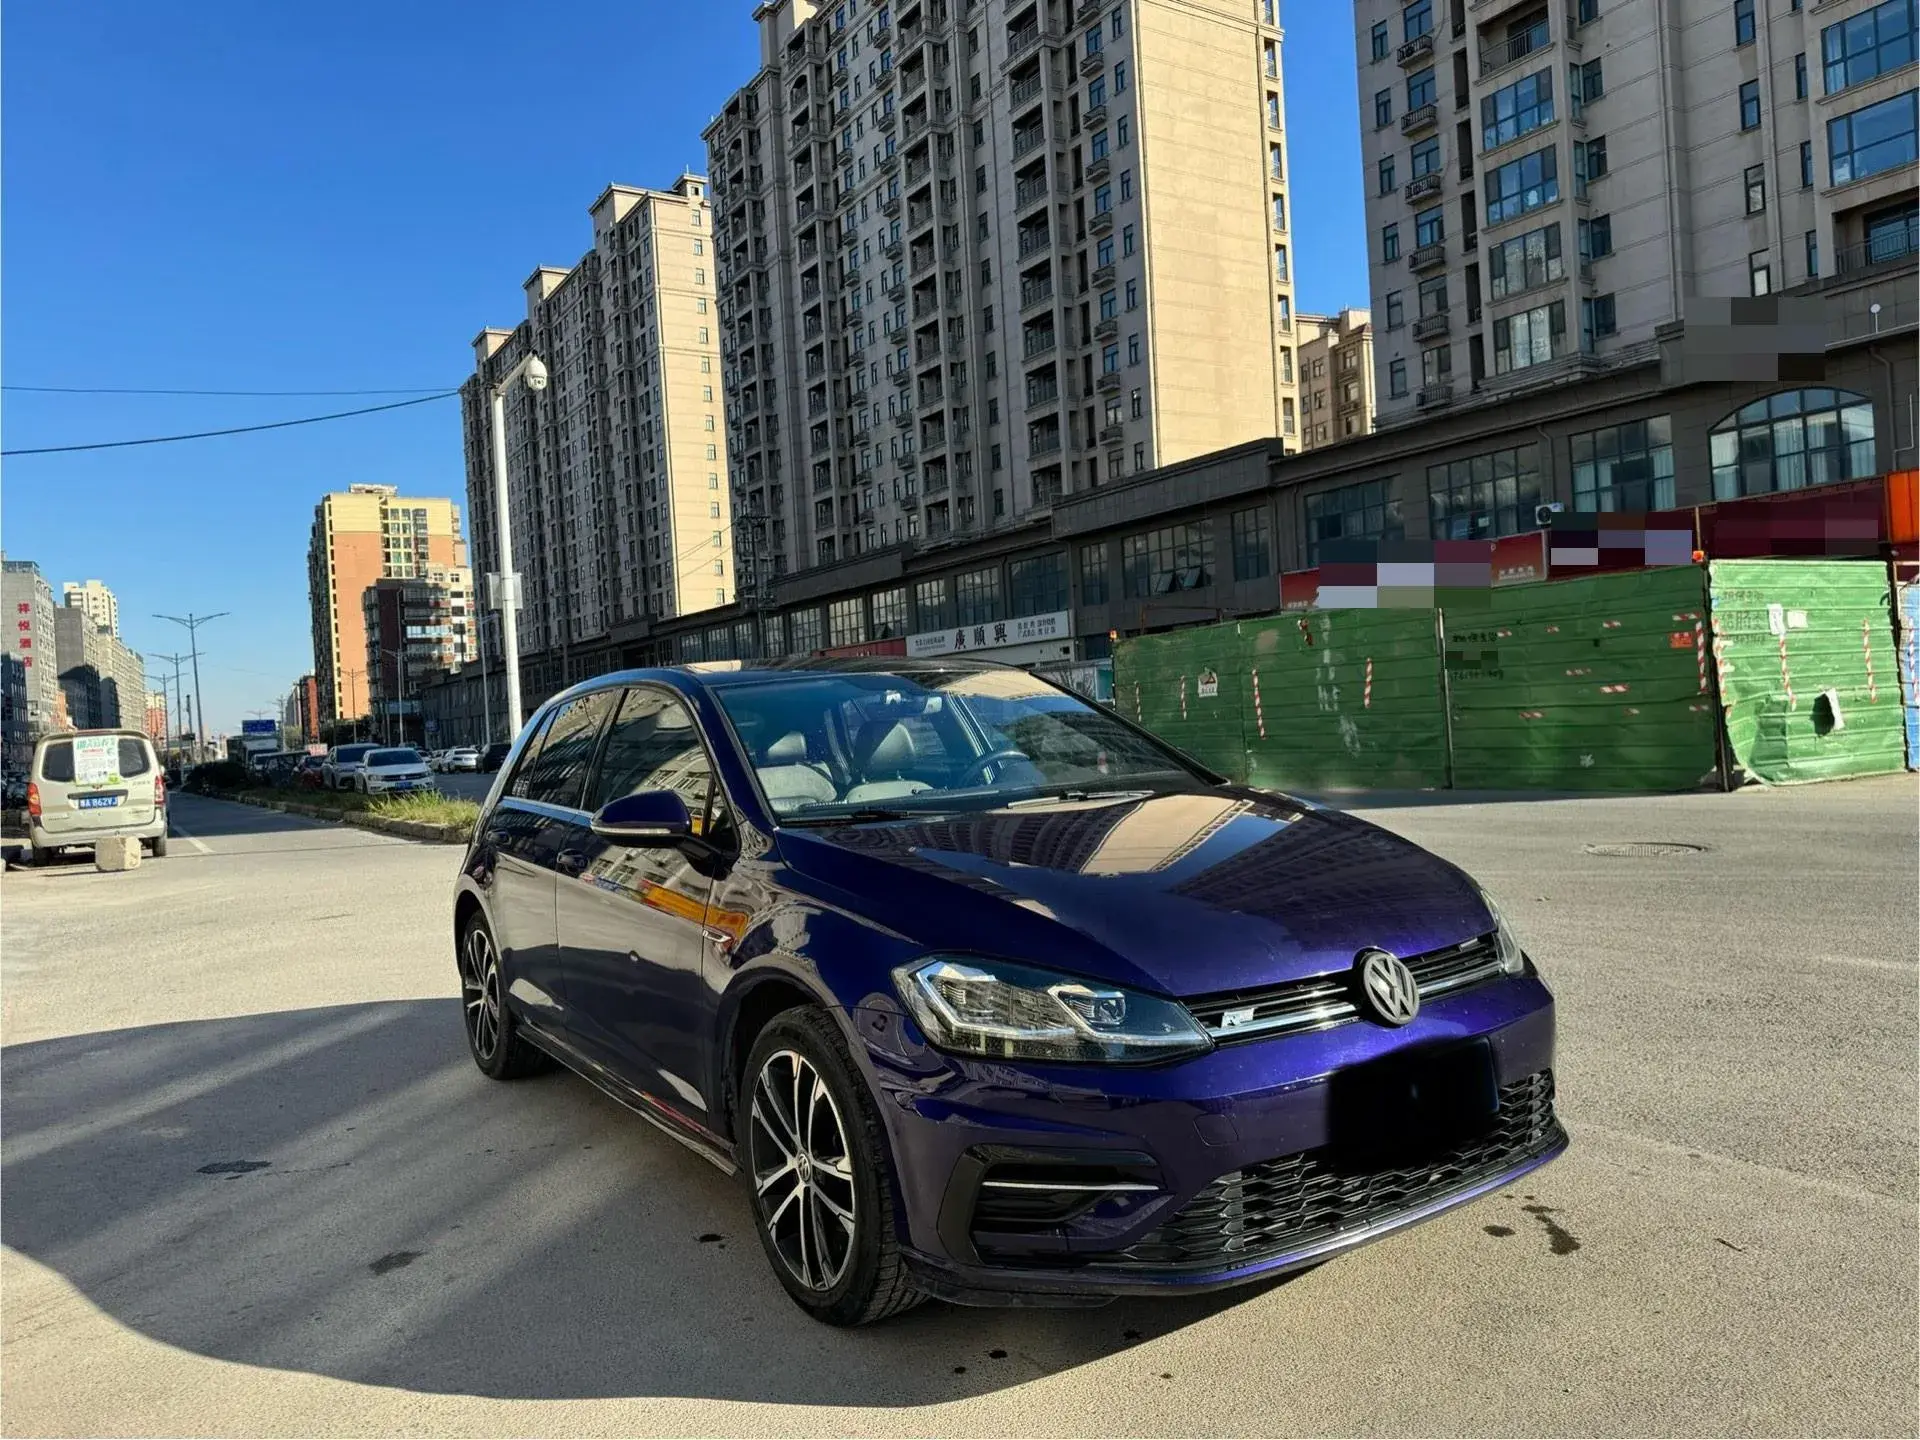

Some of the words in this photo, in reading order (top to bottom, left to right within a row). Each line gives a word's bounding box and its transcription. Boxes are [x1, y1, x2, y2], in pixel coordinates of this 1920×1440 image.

[17, 602, 33, 668] 祥悦酒店
[954, 622, 1008, 650] 廣順興
